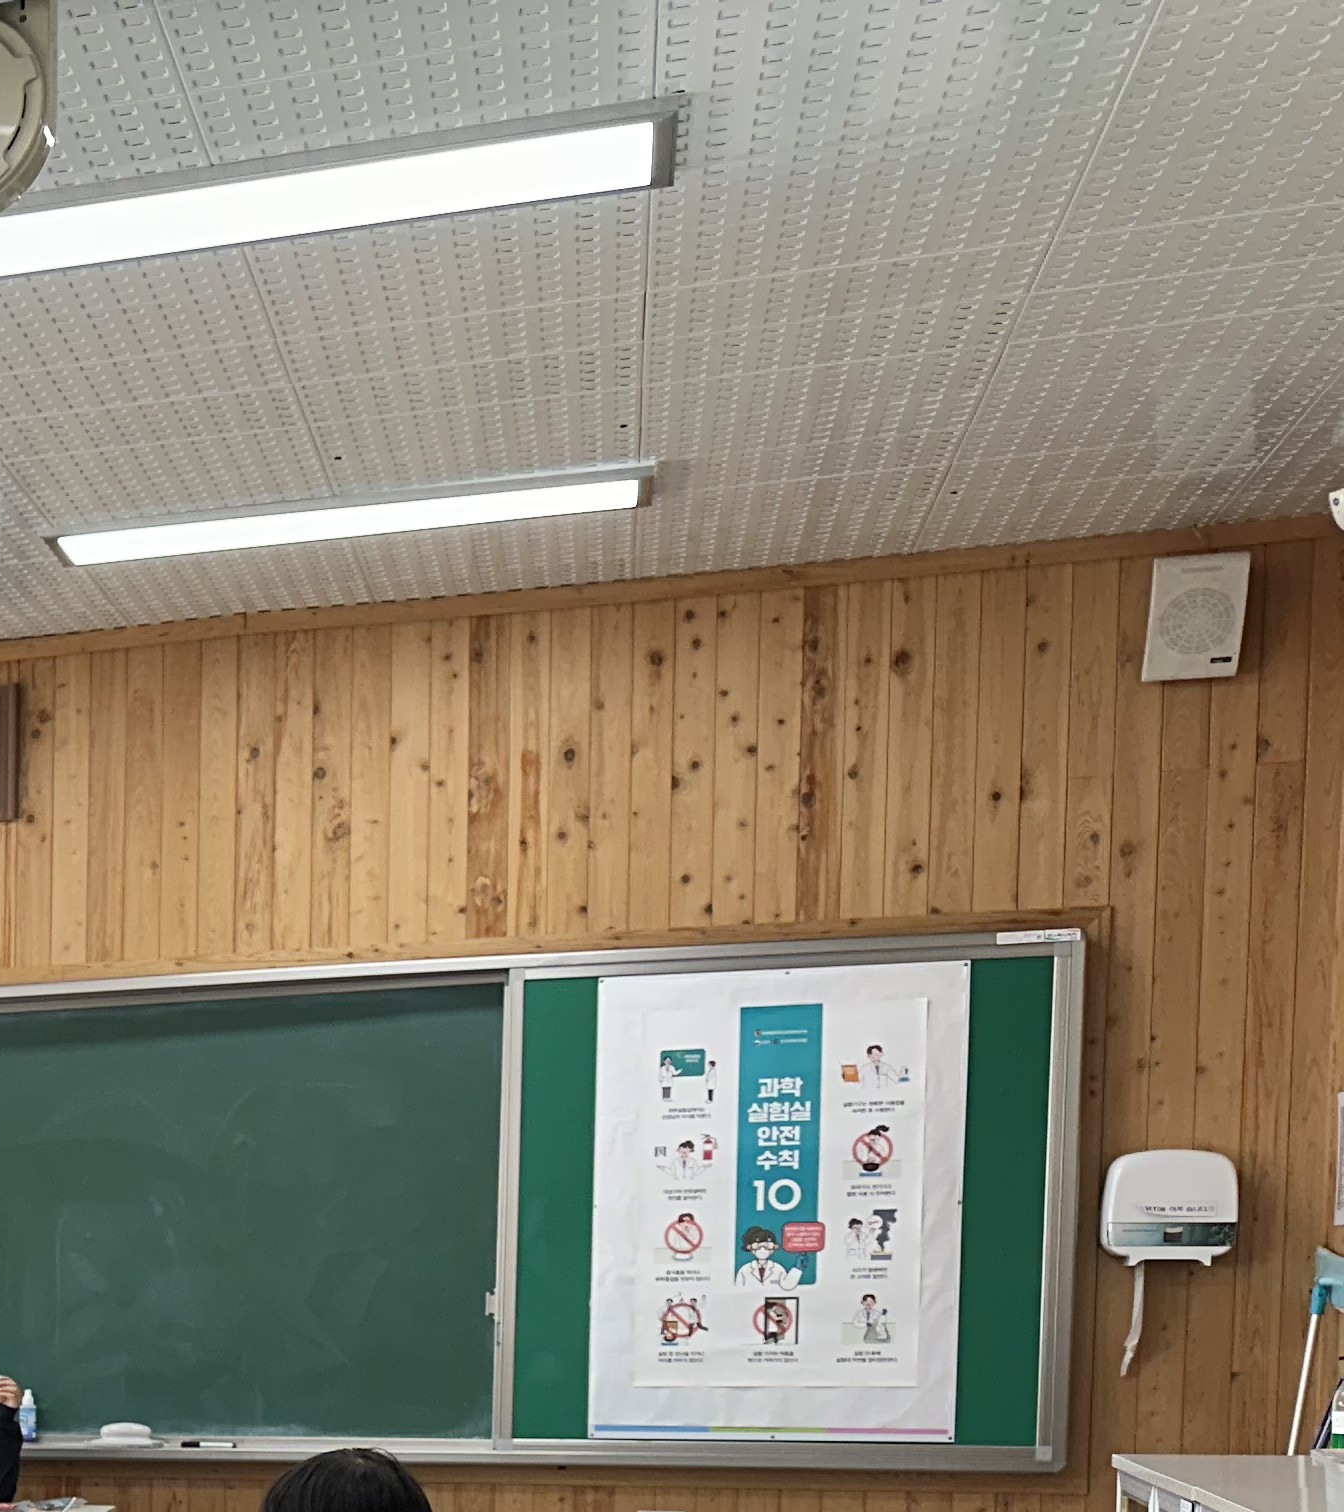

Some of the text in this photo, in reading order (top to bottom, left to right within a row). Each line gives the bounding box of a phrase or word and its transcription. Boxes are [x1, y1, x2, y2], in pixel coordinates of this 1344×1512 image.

[757, 1076, 804, 1098] 과학
[747, 1100, 811, 1123] 실험실
[757, 1125, 801, 1147] 안전
[755, 1149, 800, 1171] 수칙
[752, 1178, 802, 1211] 10
